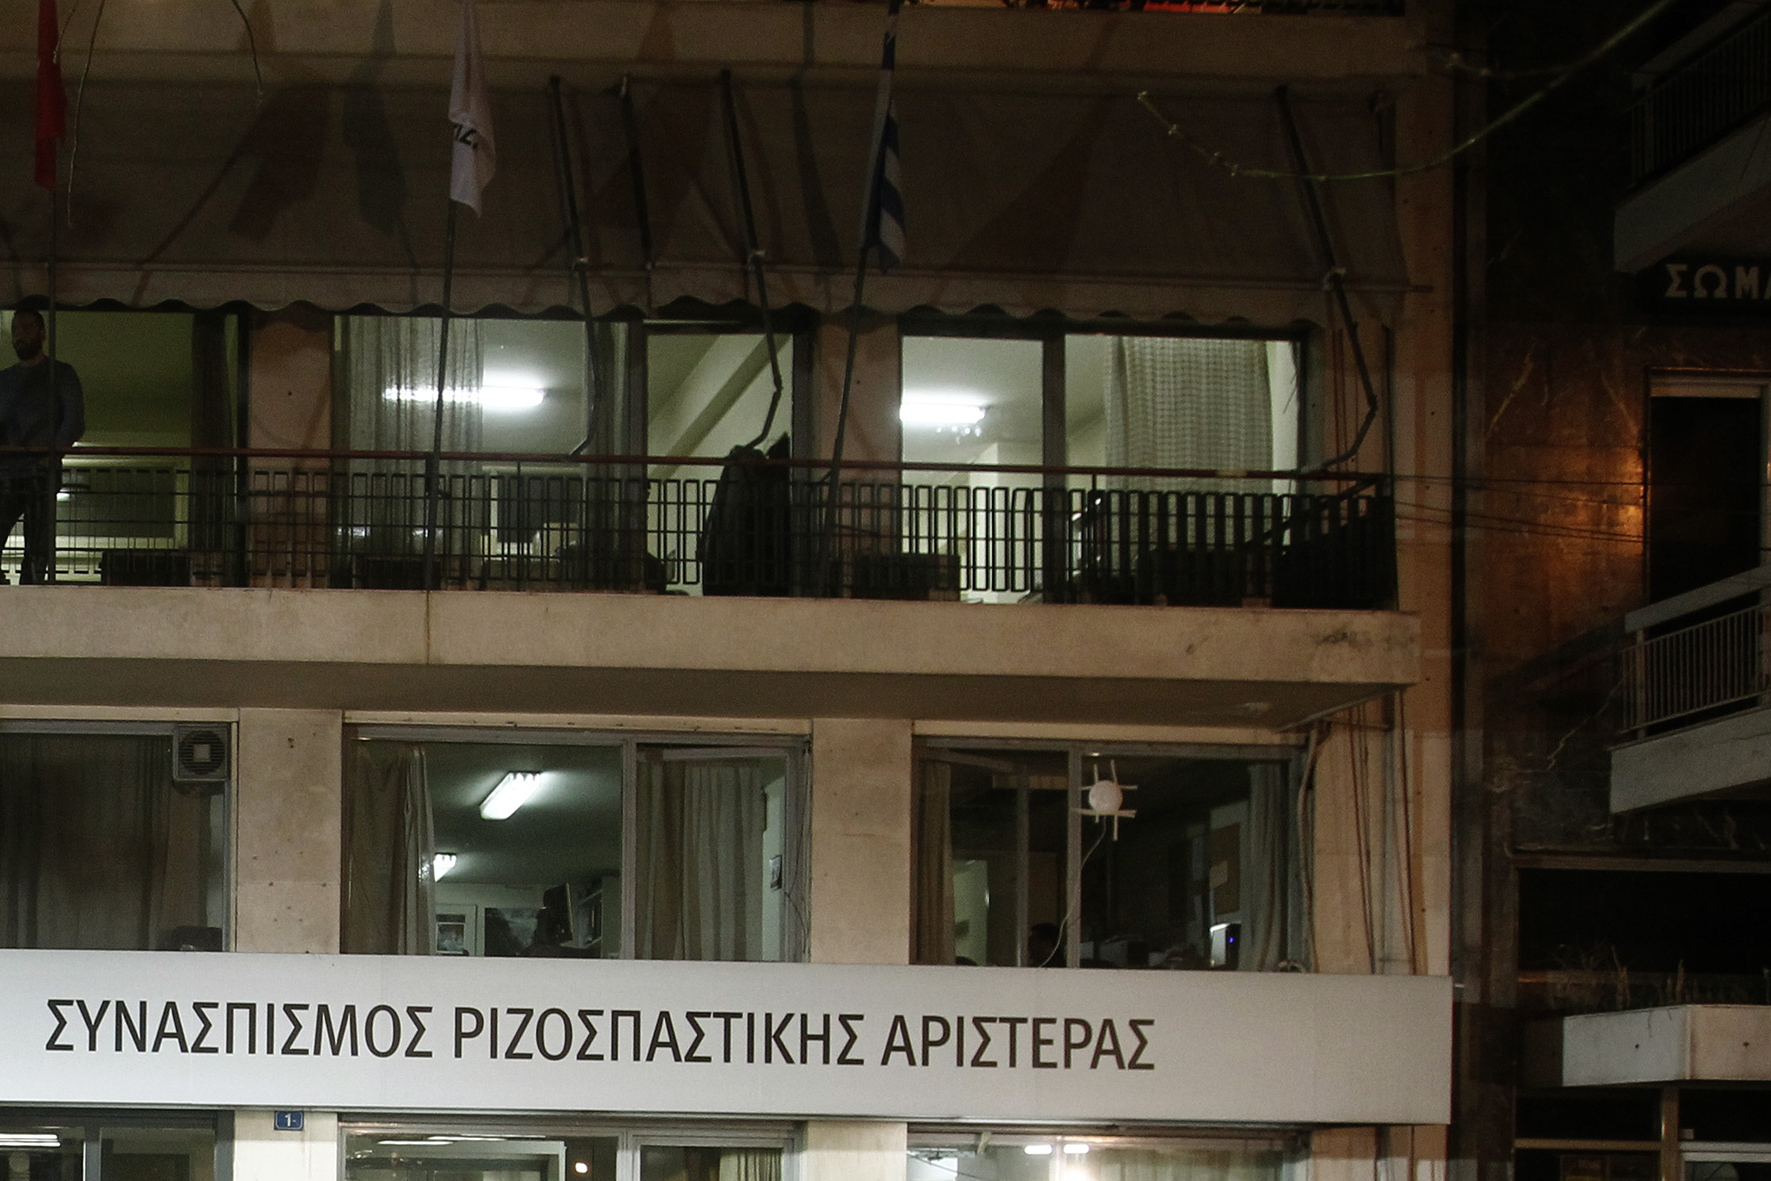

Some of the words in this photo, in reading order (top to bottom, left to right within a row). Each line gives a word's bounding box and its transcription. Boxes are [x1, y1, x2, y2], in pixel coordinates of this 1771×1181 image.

[1664, 263, 1771, 300] ΣΩΜ
[46, 1000, 432, 1057] ΣΥΝΑΣΠΙΣΜΟΣ
[455, 1007, 864, 1065] ΡΙΖΟΣΠΑΣΤΙΚΗΣ
[881, 1015, 1154, 1069] ΑΡΙΣΤΕΡΑΣ
